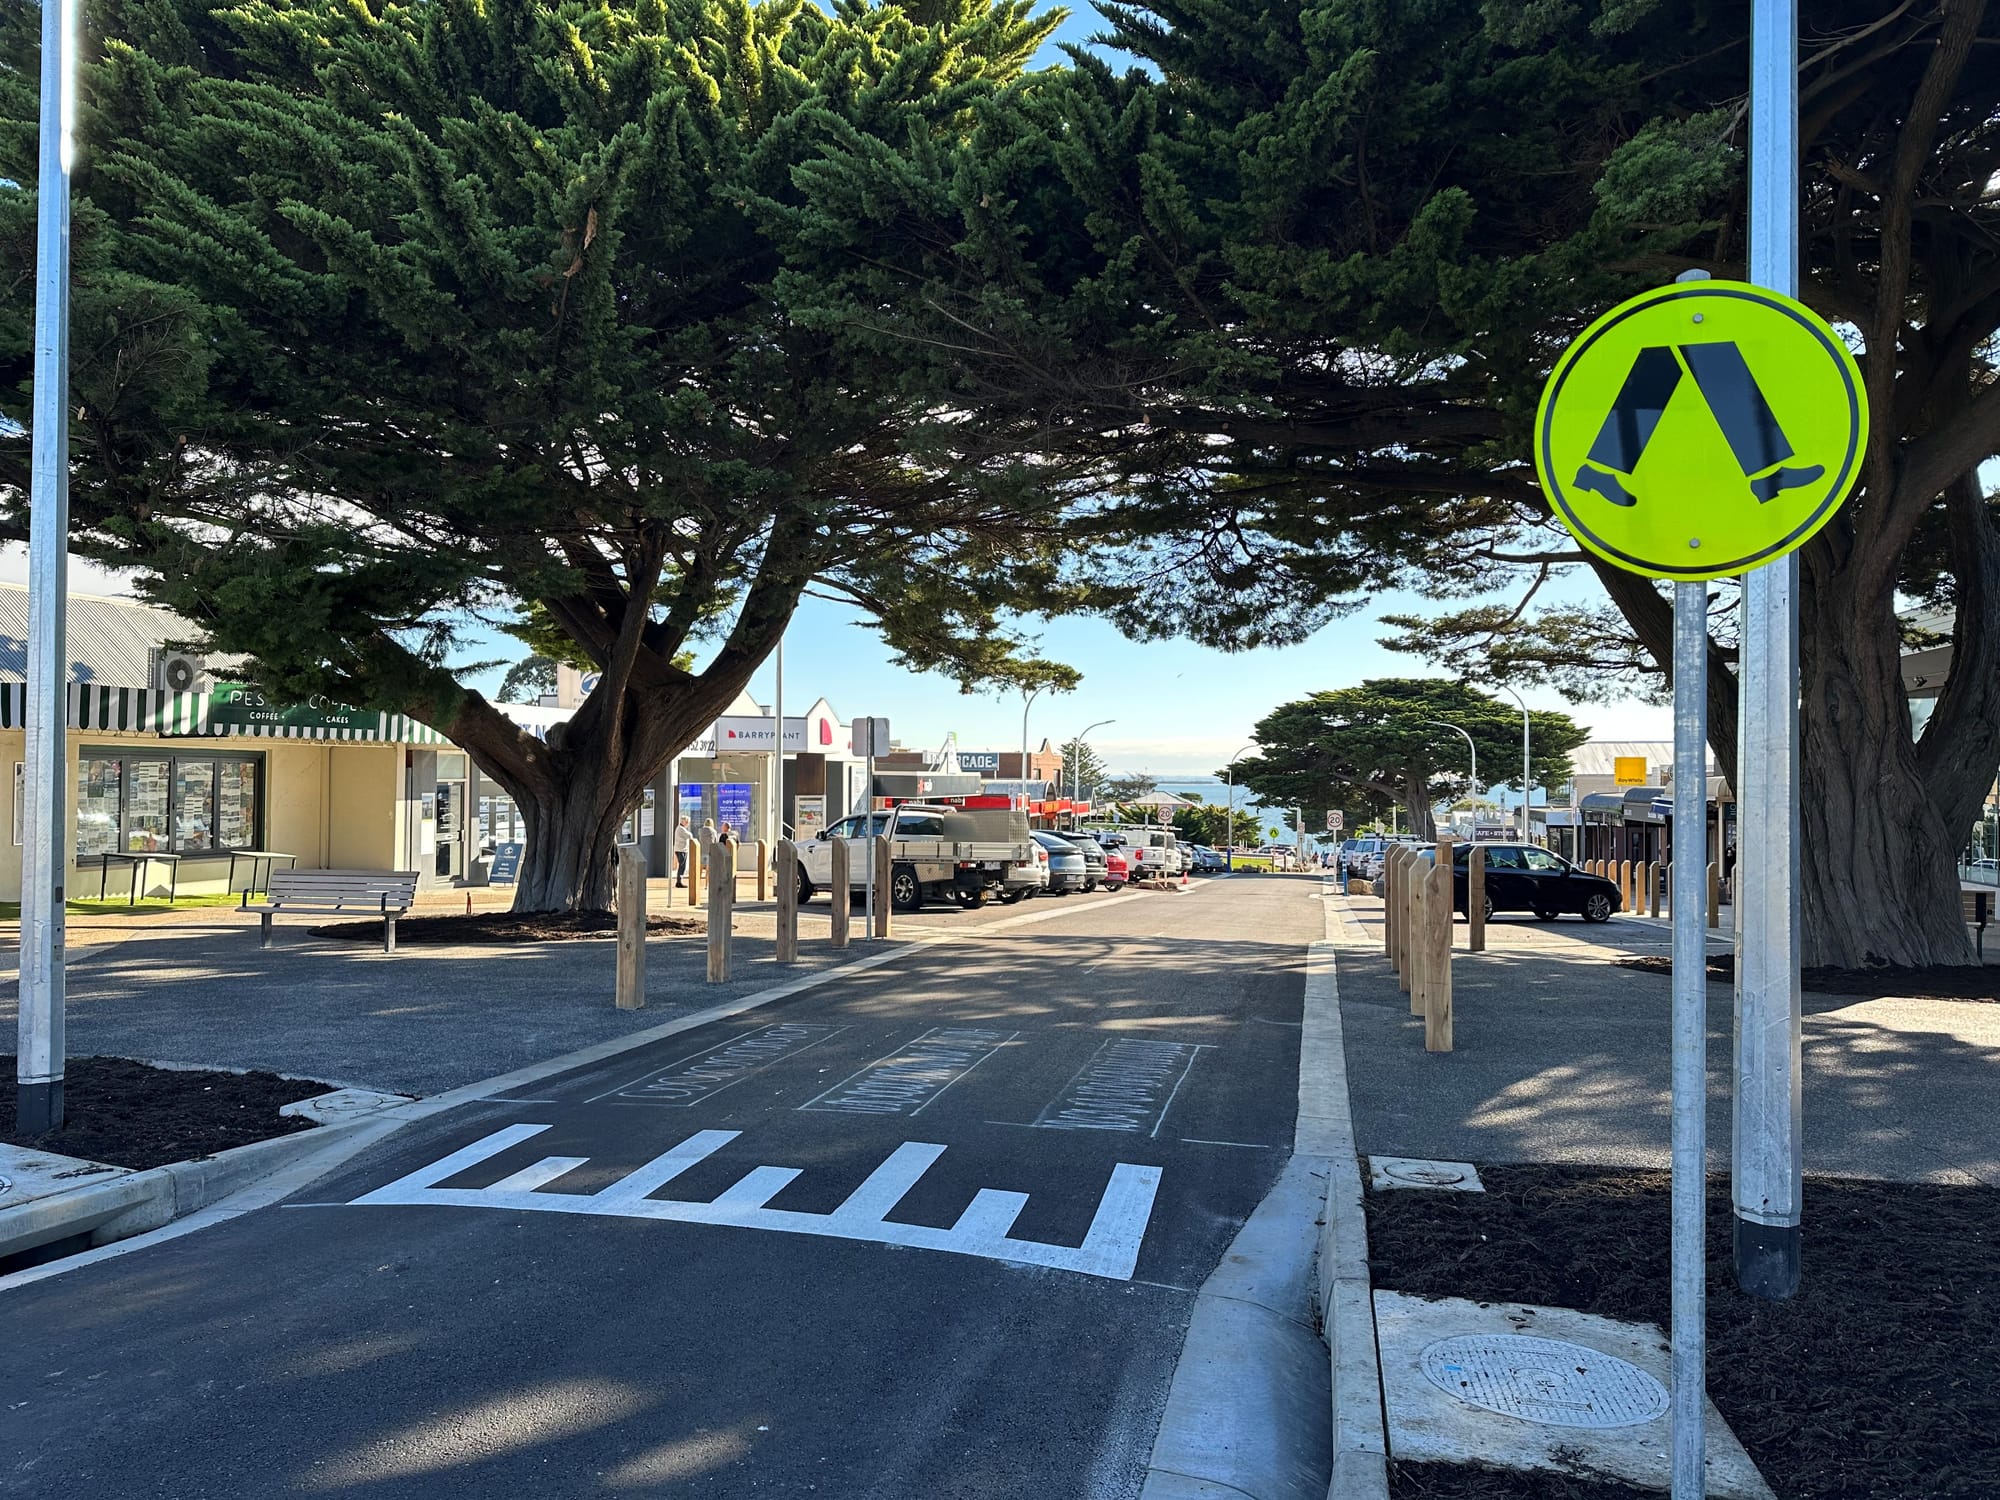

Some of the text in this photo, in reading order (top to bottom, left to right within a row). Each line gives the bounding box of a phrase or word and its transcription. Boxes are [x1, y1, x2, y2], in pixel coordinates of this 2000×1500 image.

[230, 689, 298, 708] PES
[249, 711, 278, 721] COFFEE
[325, 715, 349, 724] CAKES
[738, 731, 800, 740] BARRYPANT
[1160, 810, 1170, 818] 20
[1330, 816, 1340, 824] 20
